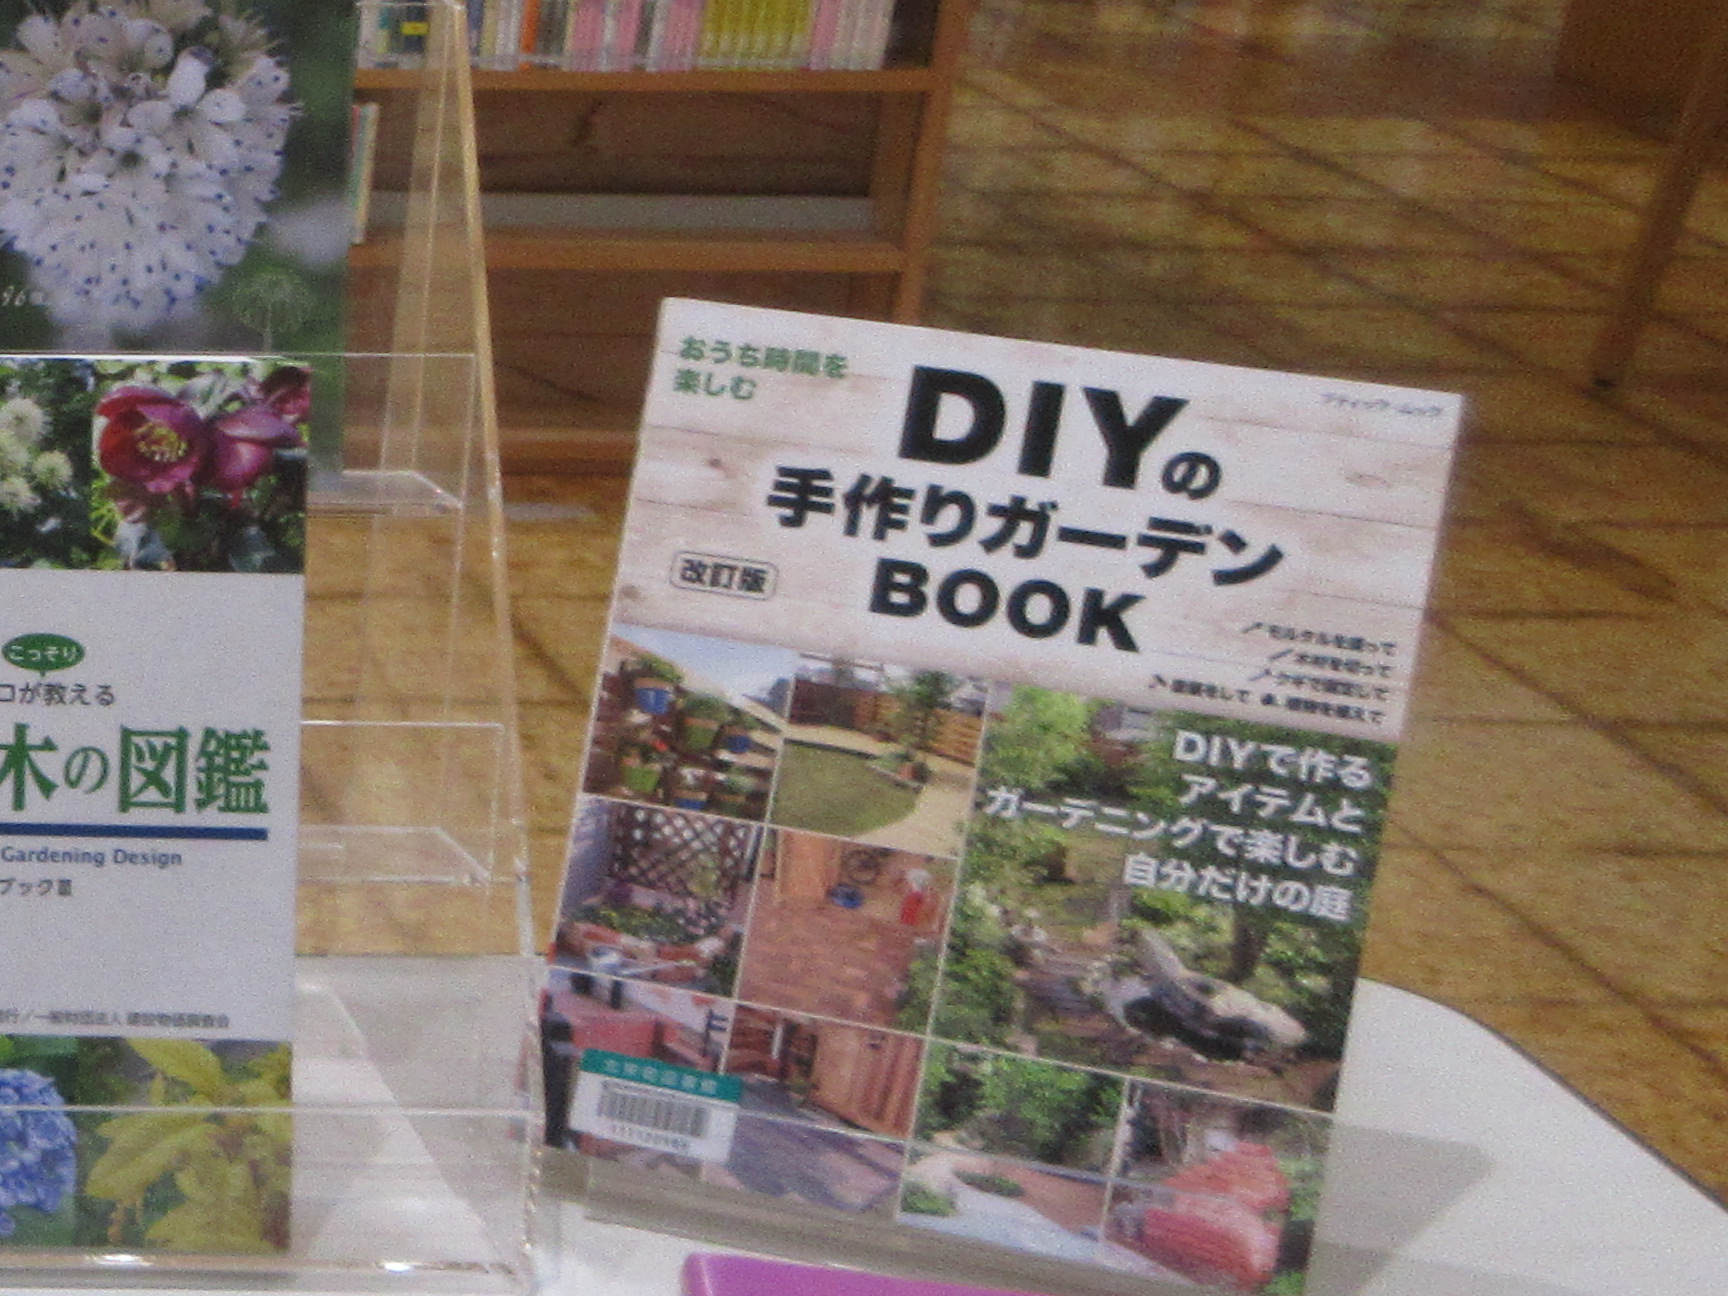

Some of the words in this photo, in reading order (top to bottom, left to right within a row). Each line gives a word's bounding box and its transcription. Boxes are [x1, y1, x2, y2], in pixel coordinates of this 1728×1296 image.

[672, 367, 759, 403] 楽しむ
[679, 334, 849, 383] おうち時間を
[898, 364, 1224, 501] DIYの
[766, 466, 1286, 590] 手作りガーデン
[676, 558, 771, 596] 改訂版
[869, 558, 1147, 654] BOOK
[8, 642, 78, 664] こっそり
[1173, 730, 1375, 789] DIYで作る
[981, 785, 1358, 878] ガーデニングで楽しむ
[1181, 775, 1367, 835] アイテムと
[1, 843, 106, 868] Gardening
[113, 848, 183, 869] Design
[1121, 855, 1354, 923] 自分だけの庭
